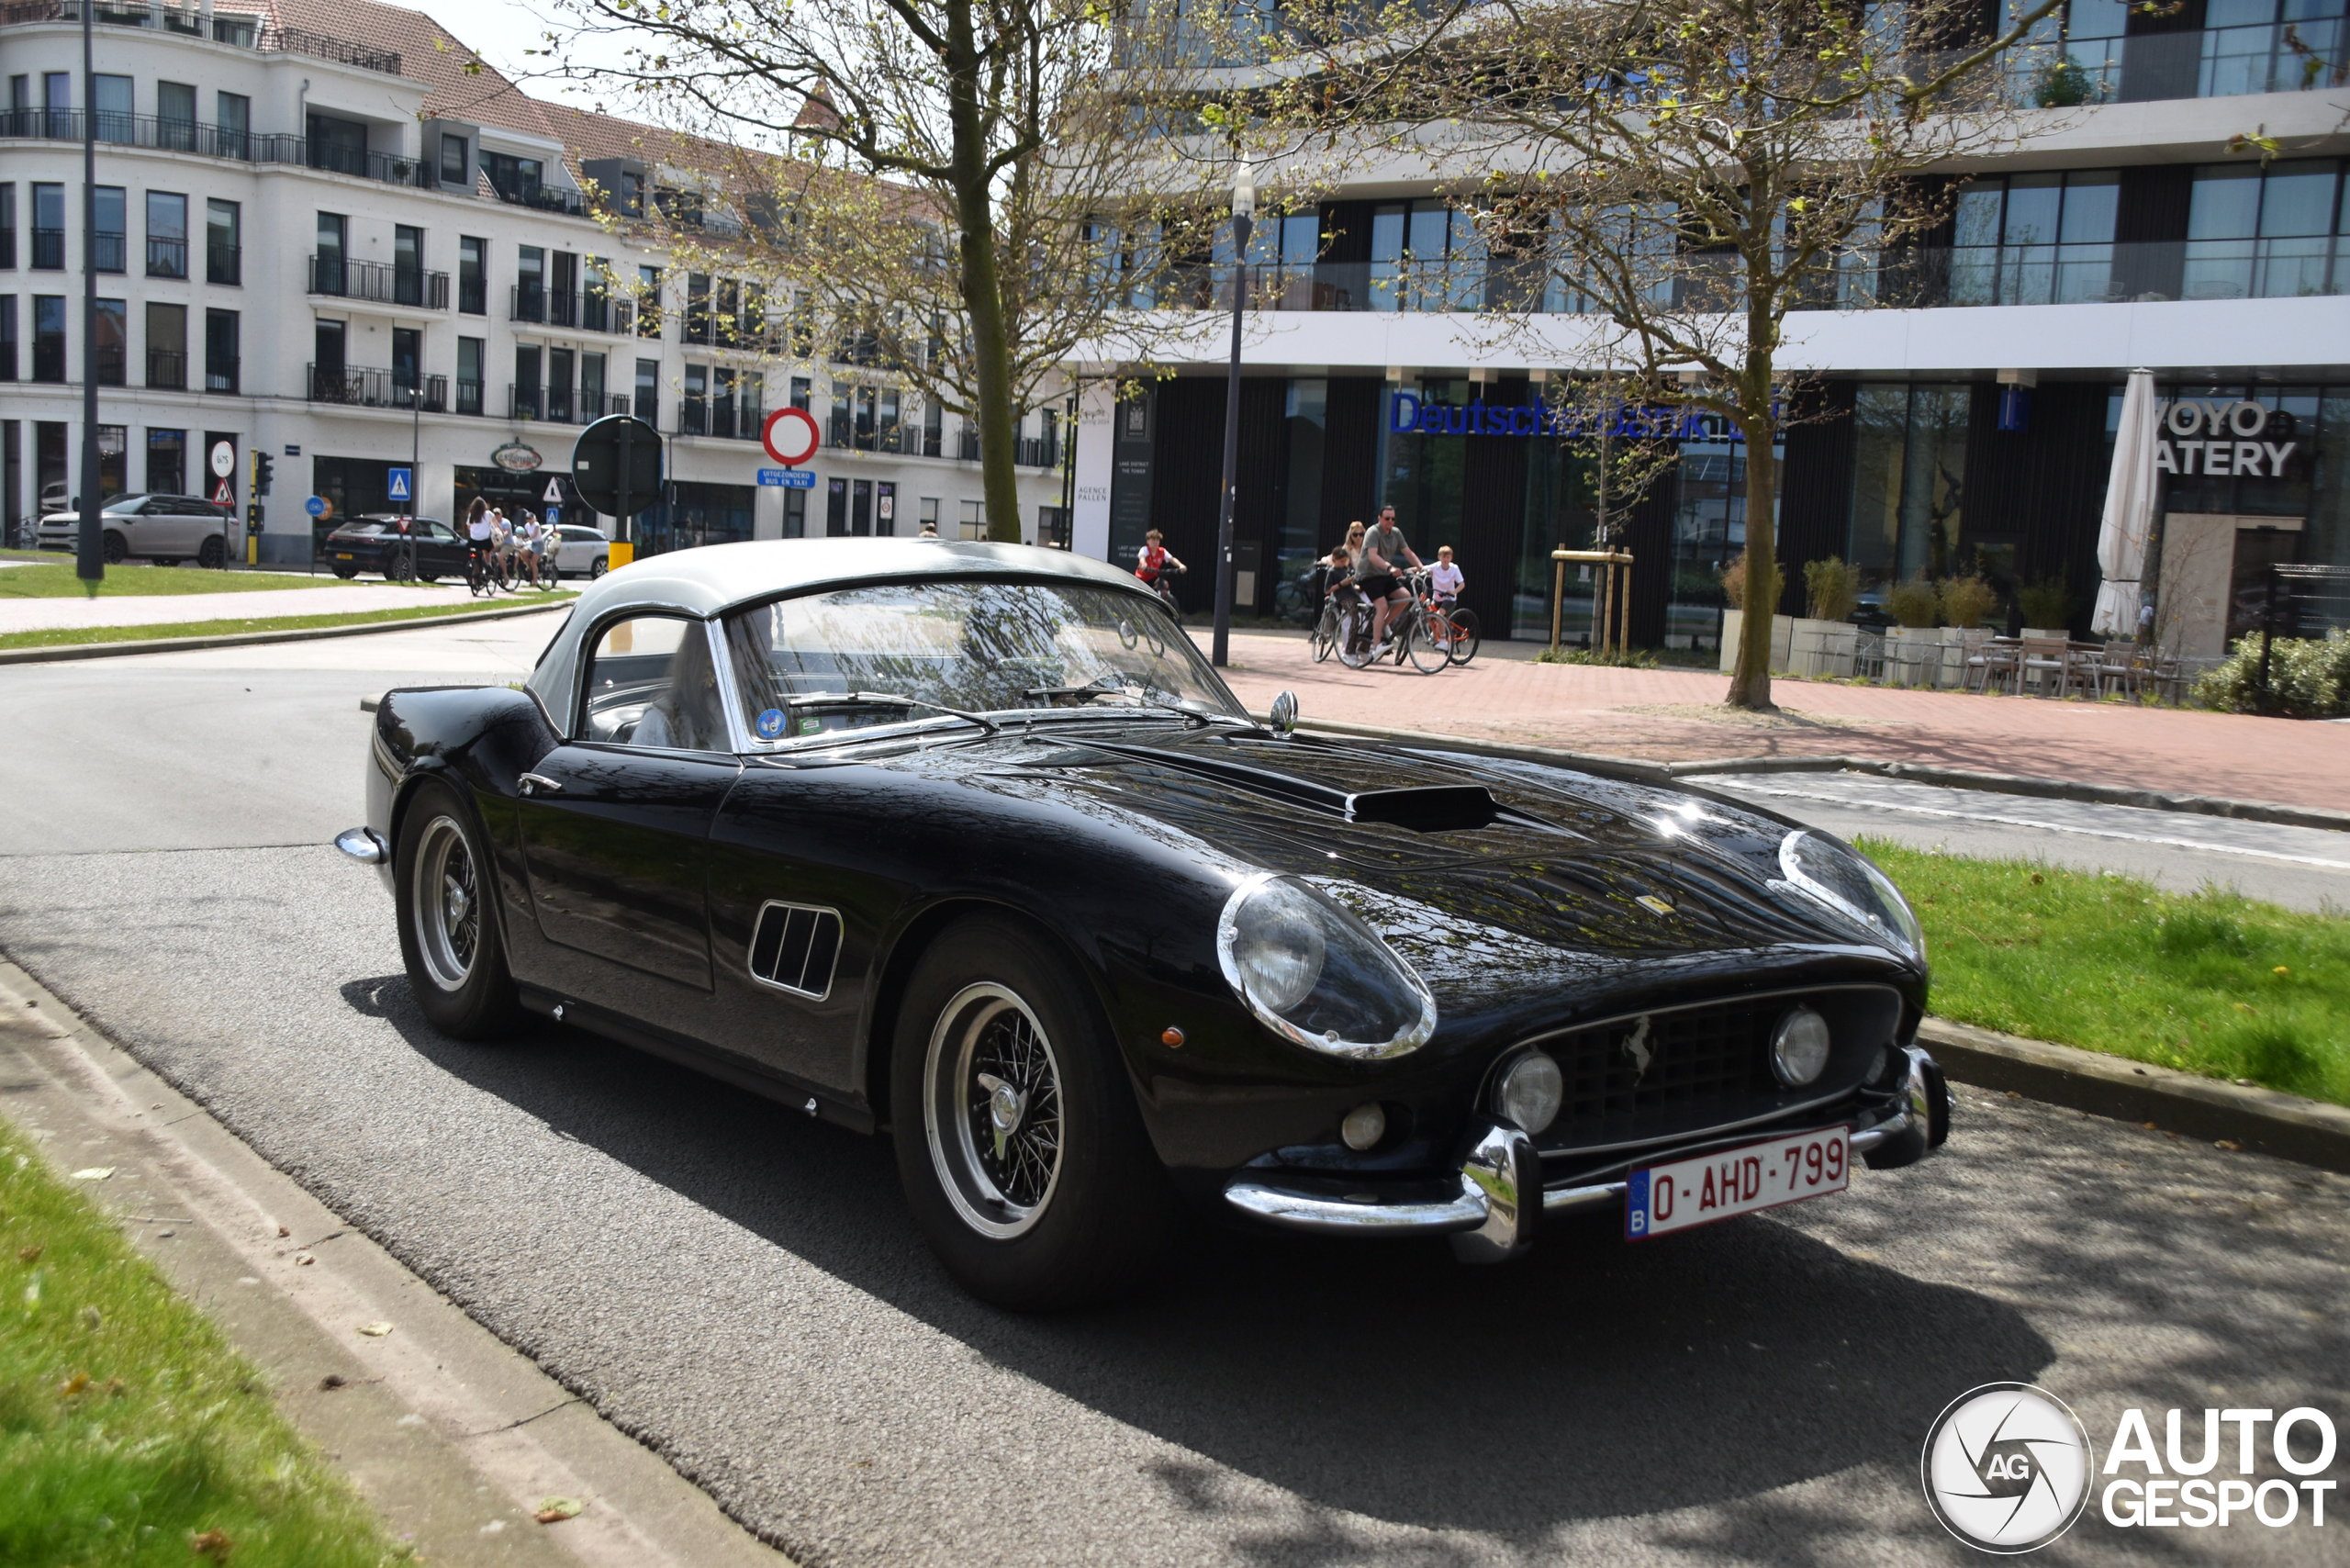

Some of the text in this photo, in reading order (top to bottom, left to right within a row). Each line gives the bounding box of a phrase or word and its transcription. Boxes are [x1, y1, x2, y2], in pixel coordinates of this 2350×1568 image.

[1390, 393, 1583, 437] Deutsche
[2156, 440, 2298, 476] ATERY
[763, 469, 811, 479] UITGEZONDERD
[1631, 1209, 1645, 1232] B
